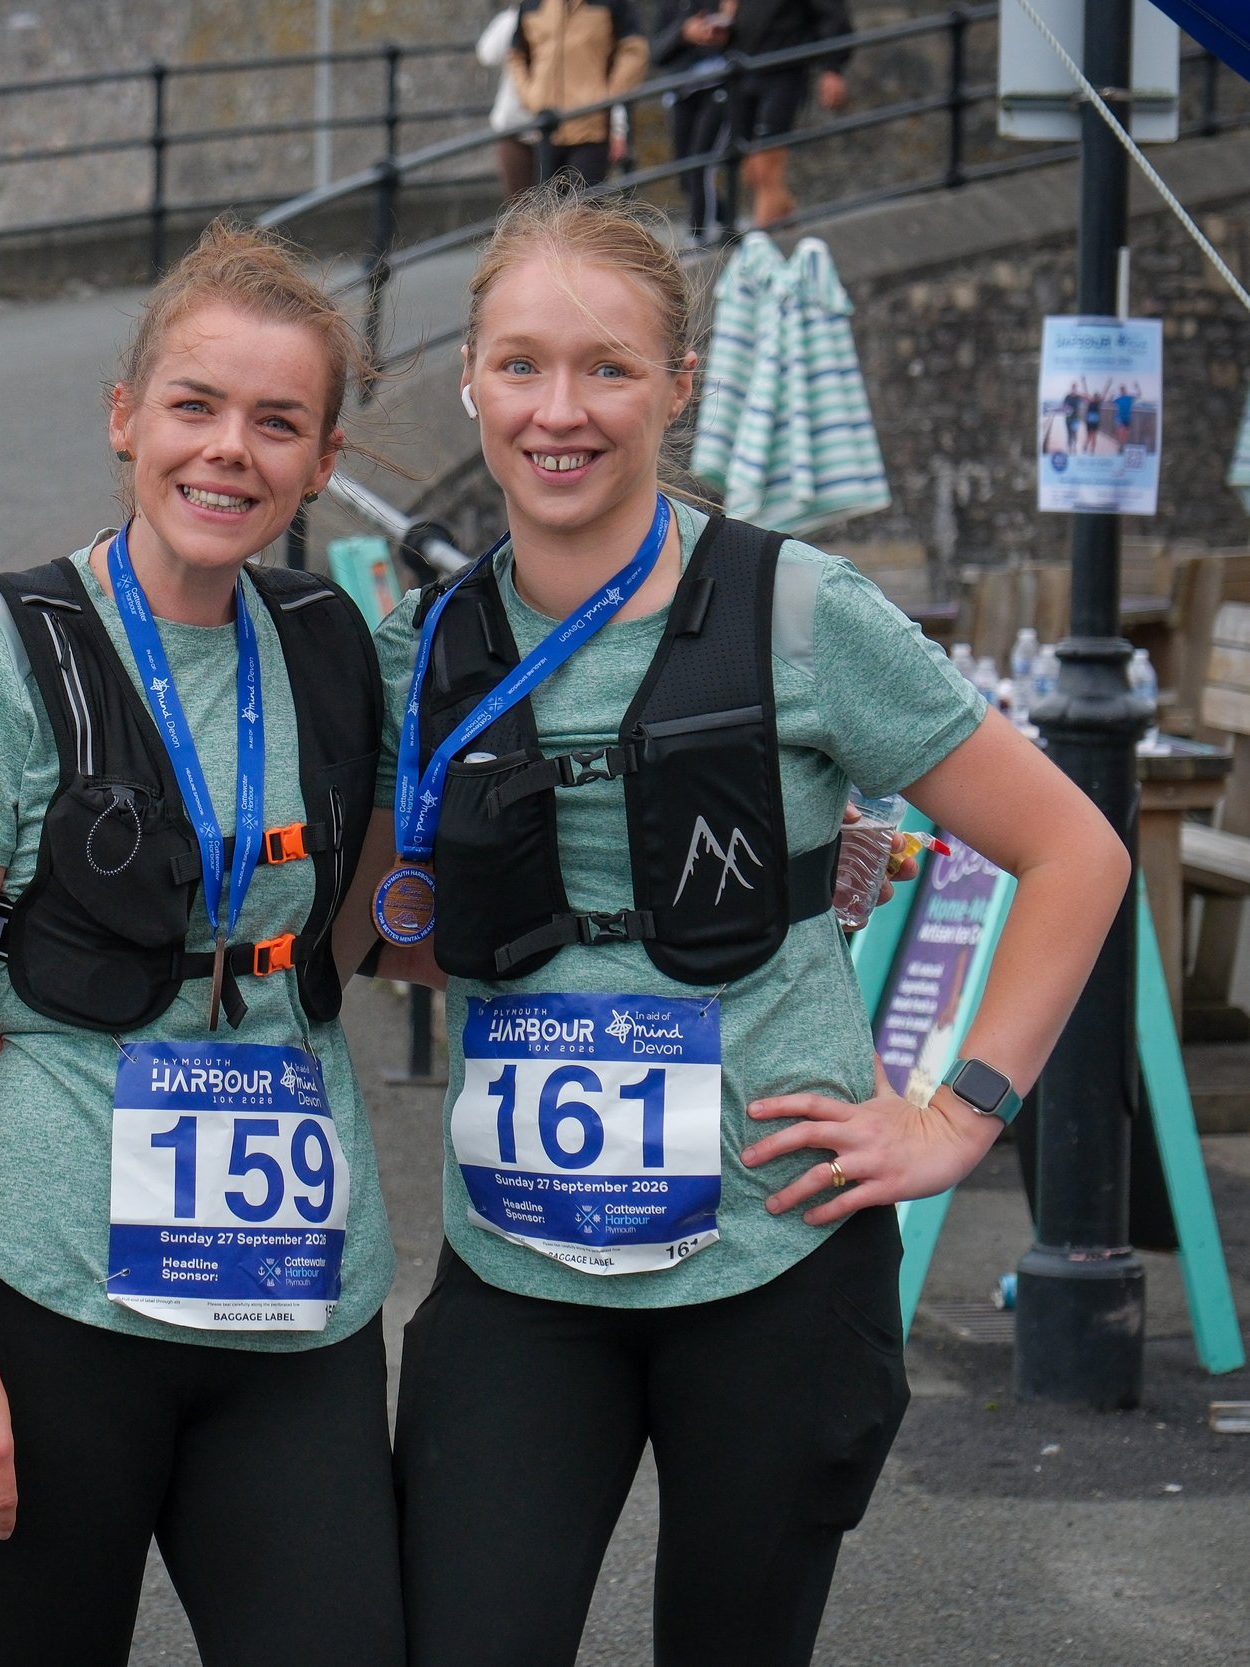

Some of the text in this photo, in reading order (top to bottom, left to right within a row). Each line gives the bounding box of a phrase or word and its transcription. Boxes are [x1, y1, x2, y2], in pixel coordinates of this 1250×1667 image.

[125, 590, 137, 615] Harbour
[132, 588, 147, 622] Cattewater
[559, 598, 611, 643] mind Devon
[419, 639, 428, 668] Devon
[508, 657, 547, 694] HEADLINE SPONSOR
[156, 692, 180, 749] mind Devon
[461, 714, 492, 741] Cattewater
[465, 711, 488, 732] Harbour
[186, 768, 204, 816] HEADLINE SPONSOR
[400, 775, 408, 812] Cattewater
[406, 785, 414, 813] Harbour
[416, 804, 428, 832] mind
[238, 836, 251, 887] HEADLINE SPONSOR
[384, 871, 433, 890] PLYMOUTH HARBOUR
[383, 924, 399, 940] BETTER
[400, 934, 421, 942] MENTAL
[635, 1011, 671, 1020] In aid of
[489, 1019, 594, 1042] HARBOUR
[634, 1023, 683, 1039] mind
[528, 1044, 595, 1053] 10K 2026
[633, 1041, 682, 1055] Devon
[152, 1069, 272, 1094] HARBOUR
[296, 1077, 318, 1092] mind
[242, 1097, 273, 1105] 2026
[298, 1092, 321, 1107] Devon
[488, 1064, 666, 1169] 161
[151, 1116, 334, 1223] 159
[495, 1174, 668, 1194] Sunday 27 September 2026
[503, 1197, 543, 1212] Headline
[605, 1204, 666, 1214] Cattewater
[506, 1209, 545, 1224] Sponsor:
[605, 1215, 649, 1225] Harbour
[605, 1226, 636, 1234] Plymouth
[160, 1232, 326, 1247] Sunday 27 September 2026
[163, 1257, 218, 1270] Headline
[589, 1257, 614, 1266] LABEL
[162, 1269, 218, 1282] Sponsor:
[285, 1268, 319, 1278] Harbour
[286, 1278, 310, 1287] Plymouth
[214, 1313, 295, 1321] BAGGAGE LABEL
